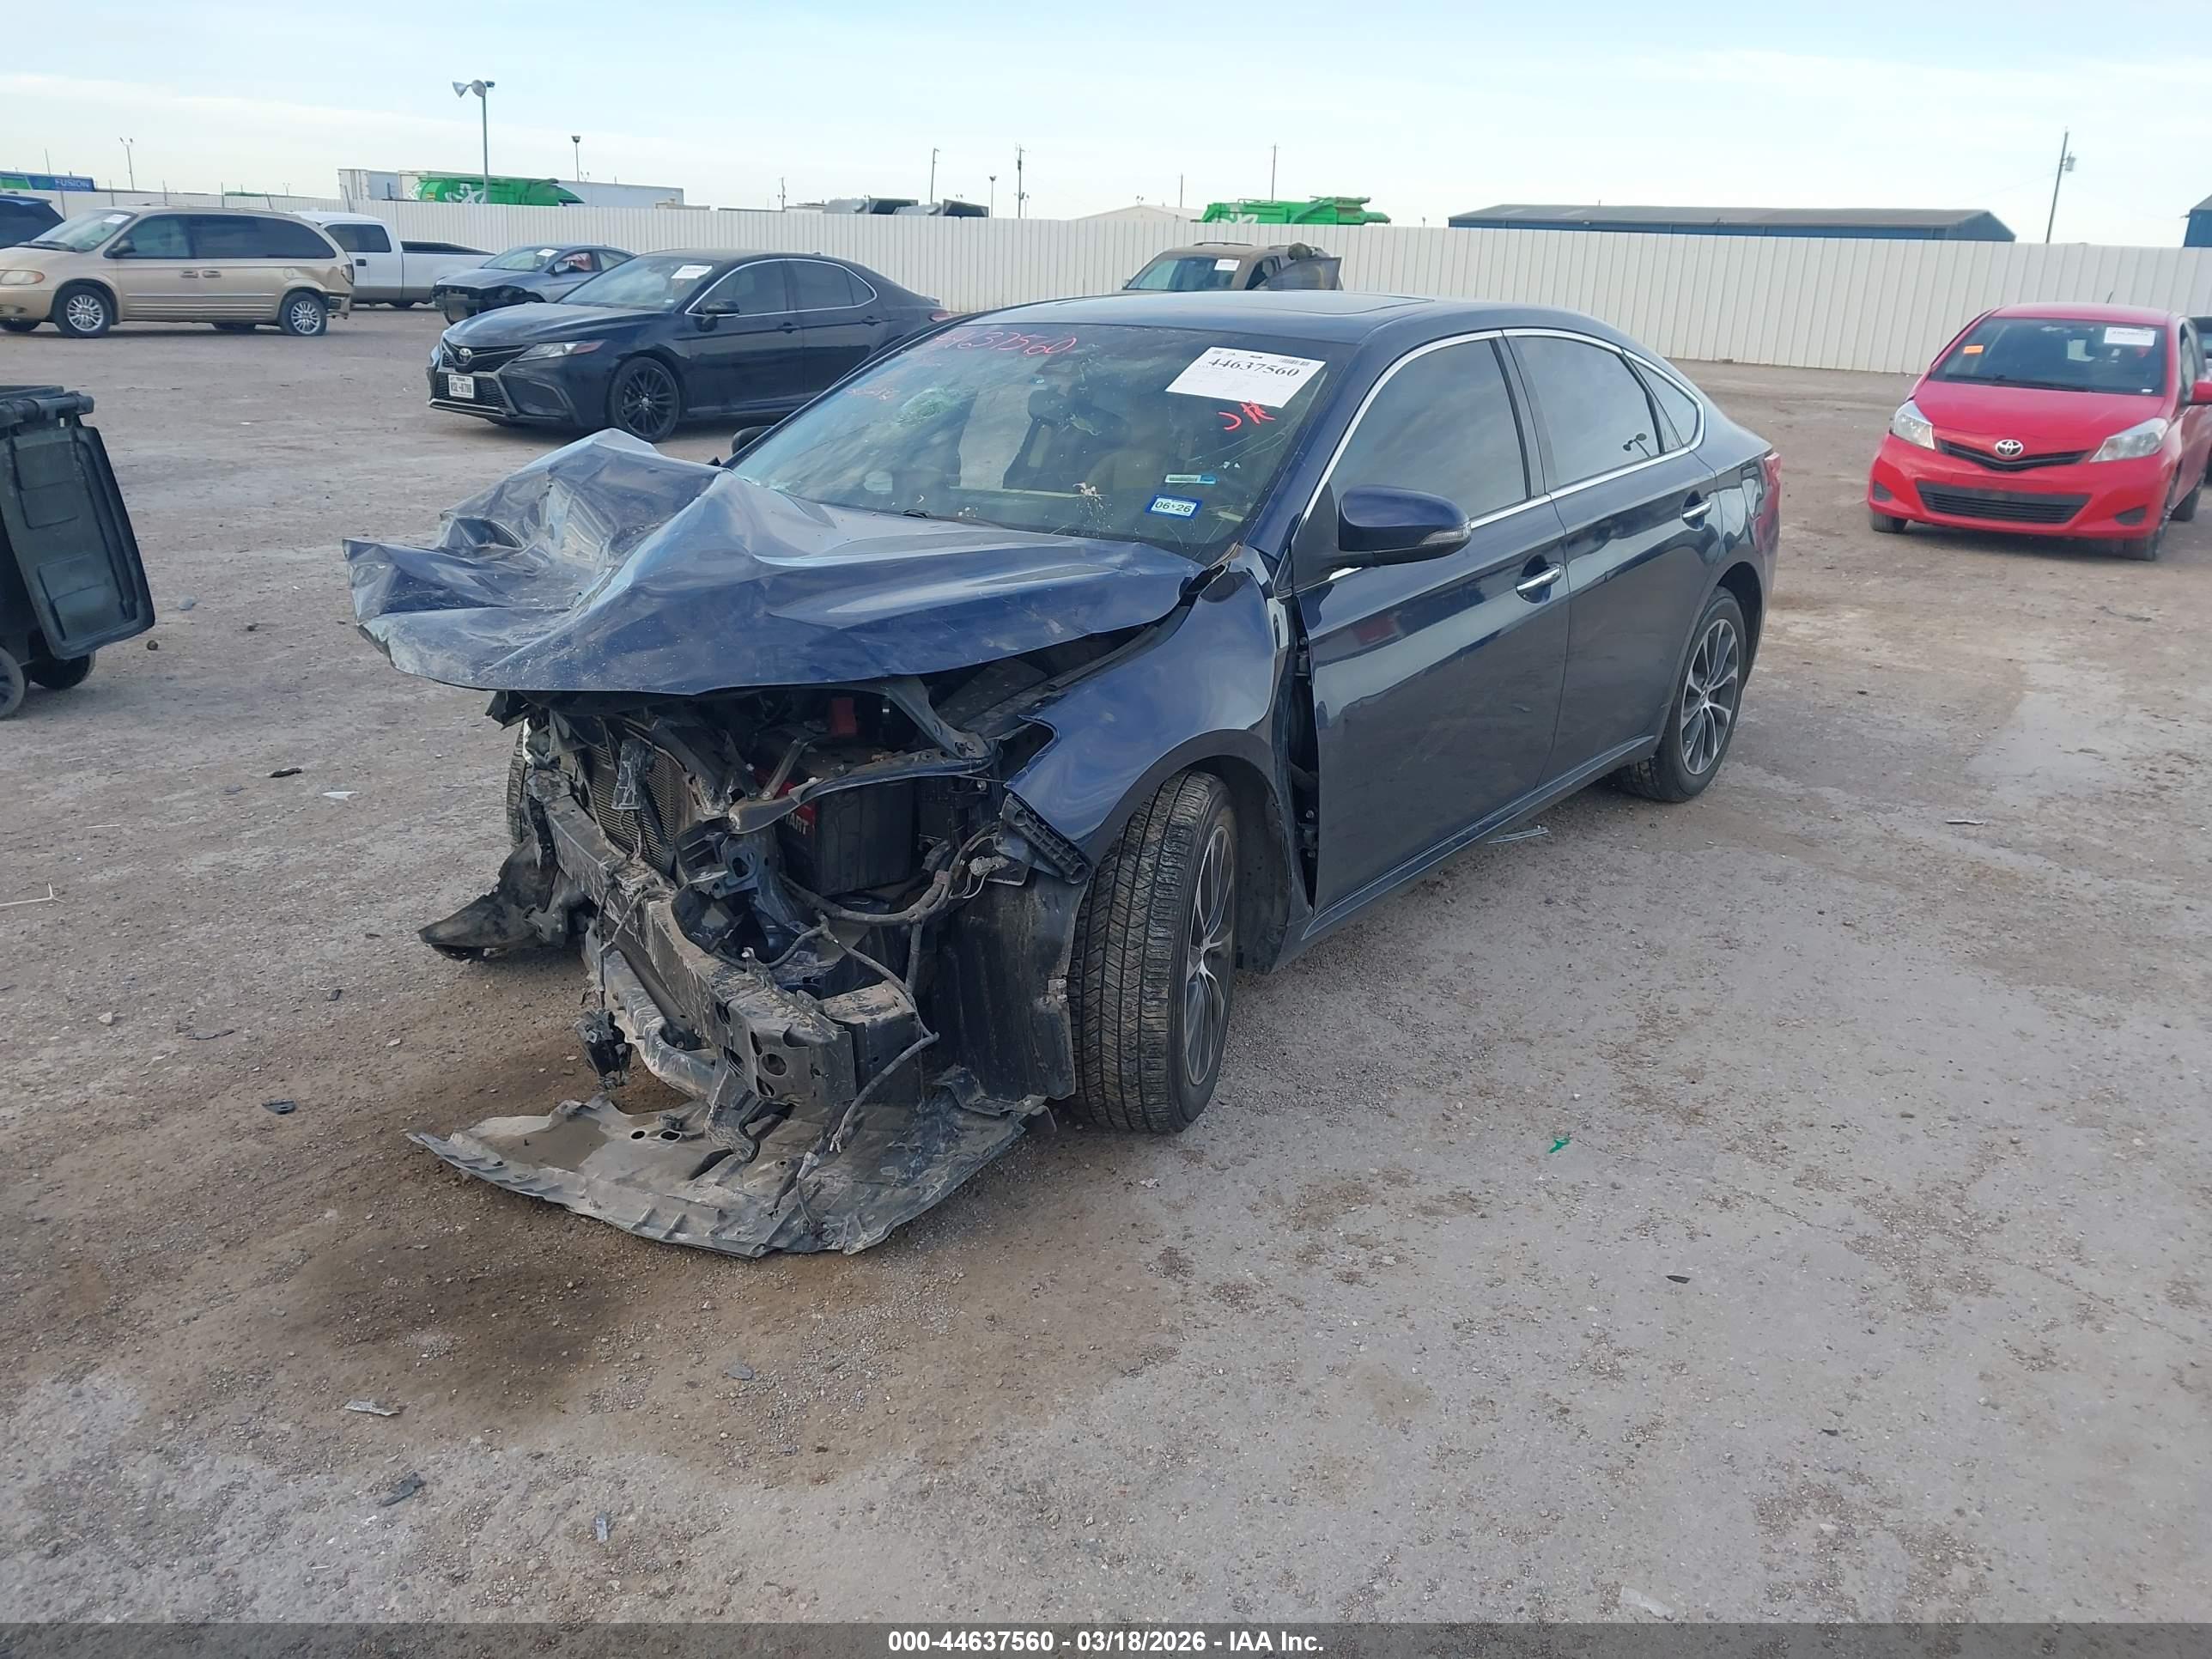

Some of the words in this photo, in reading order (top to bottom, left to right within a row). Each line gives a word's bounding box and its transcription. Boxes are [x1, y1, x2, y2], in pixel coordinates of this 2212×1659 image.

[54, 178, 89, 188] FUSION
[1207, 357, 1300, 378] 44637560
[1155, 501, 1170, 510] 06
[1175, 503, 1192, 513] 26
